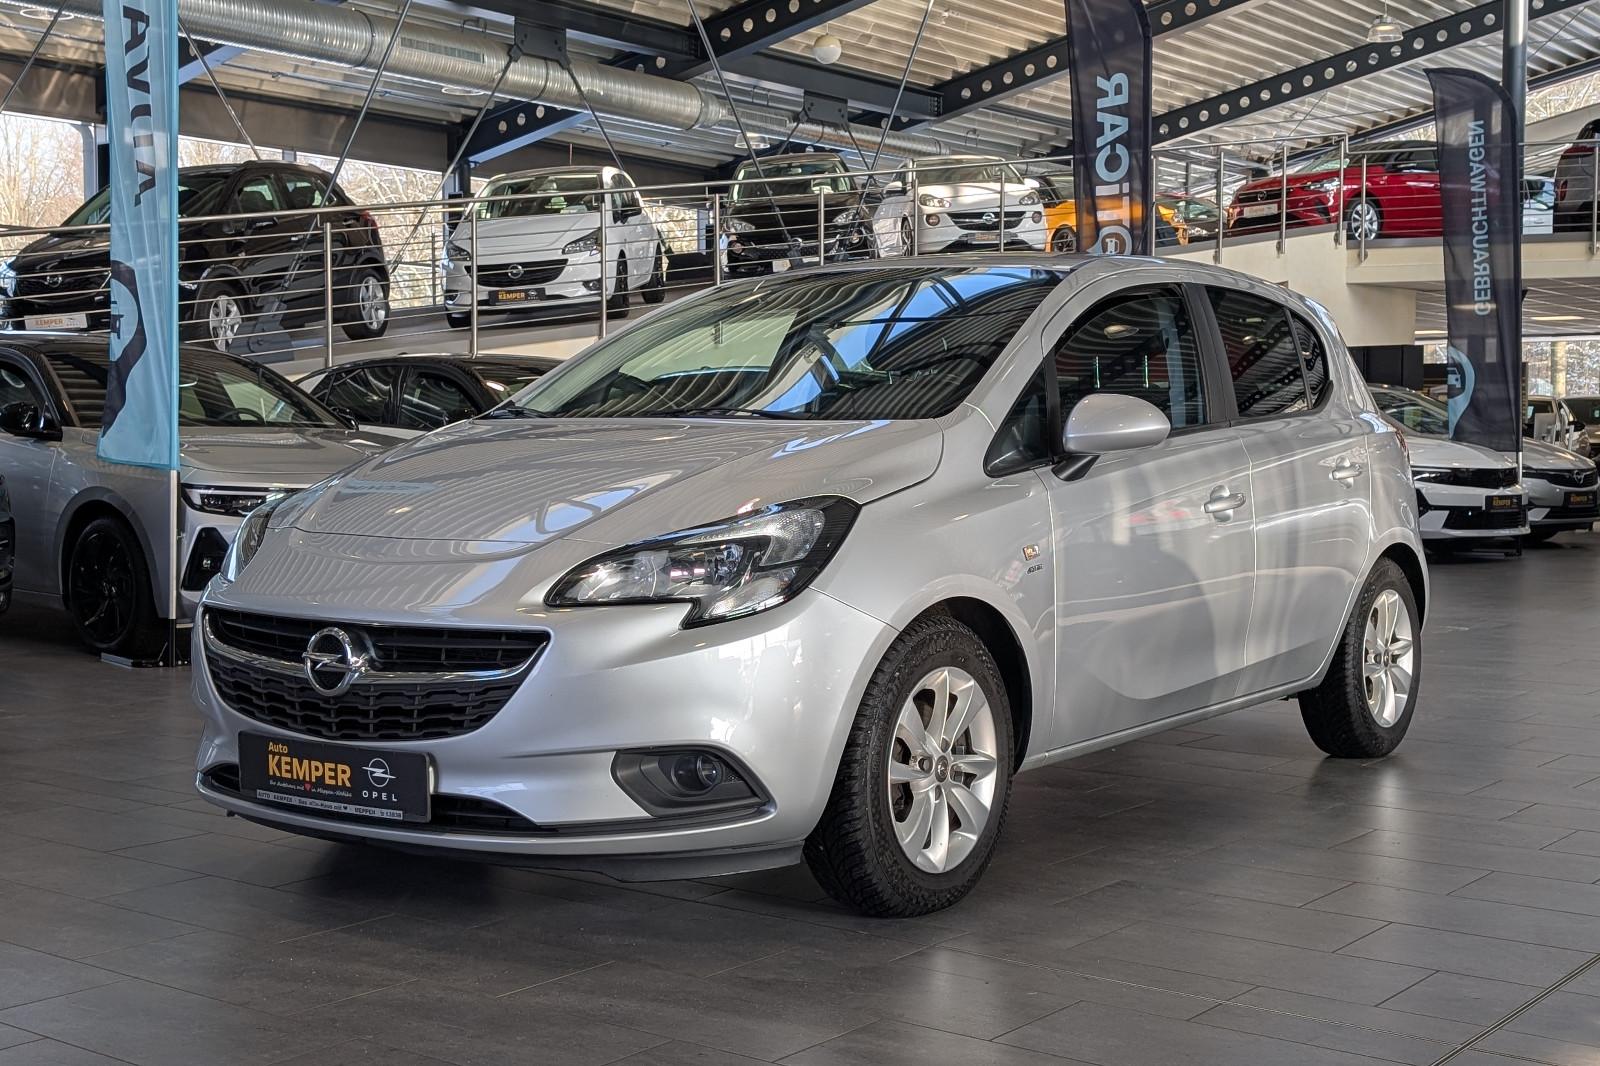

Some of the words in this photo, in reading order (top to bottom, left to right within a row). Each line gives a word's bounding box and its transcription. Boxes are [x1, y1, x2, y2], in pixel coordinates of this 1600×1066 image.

[268, 741, 288, 754] Auto
[268, 754, 351, 788] KEMPER
[362, 790, 398, 802] OPEL
